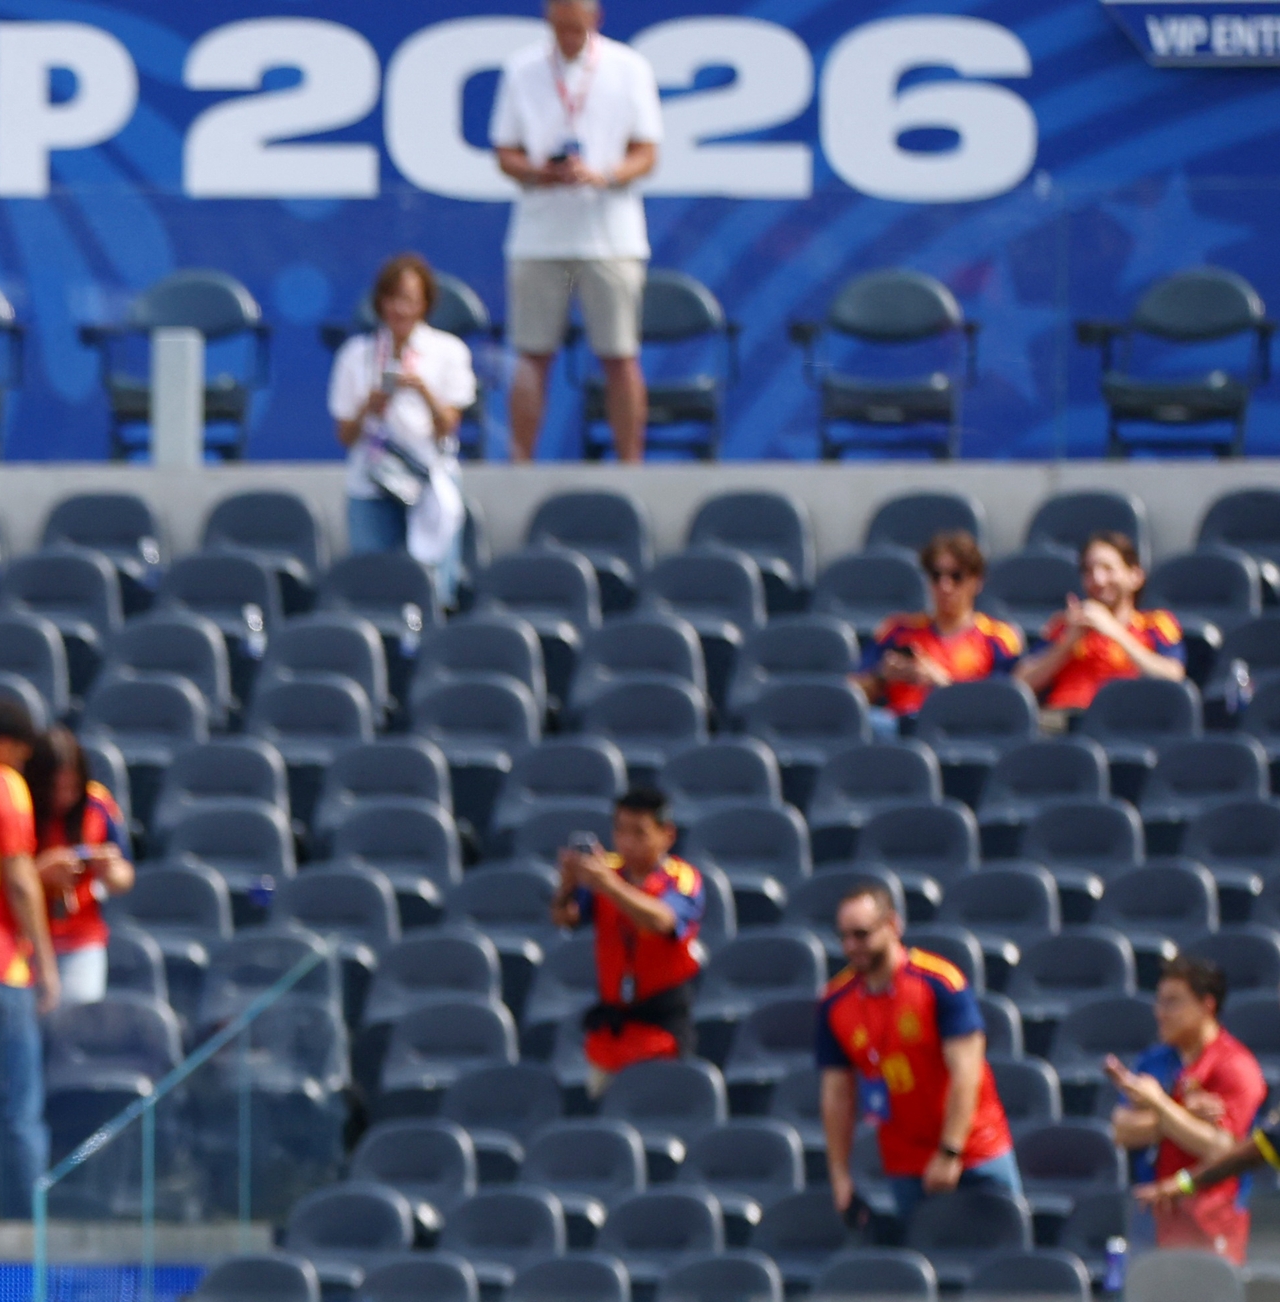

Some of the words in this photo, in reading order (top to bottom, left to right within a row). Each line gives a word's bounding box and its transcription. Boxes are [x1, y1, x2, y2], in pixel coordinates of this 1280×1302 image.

[1145, 14, 1208, 56] VIP
[1210, 14, 1280, 56] ENT
[182, 15, 1037, 203] 2026
